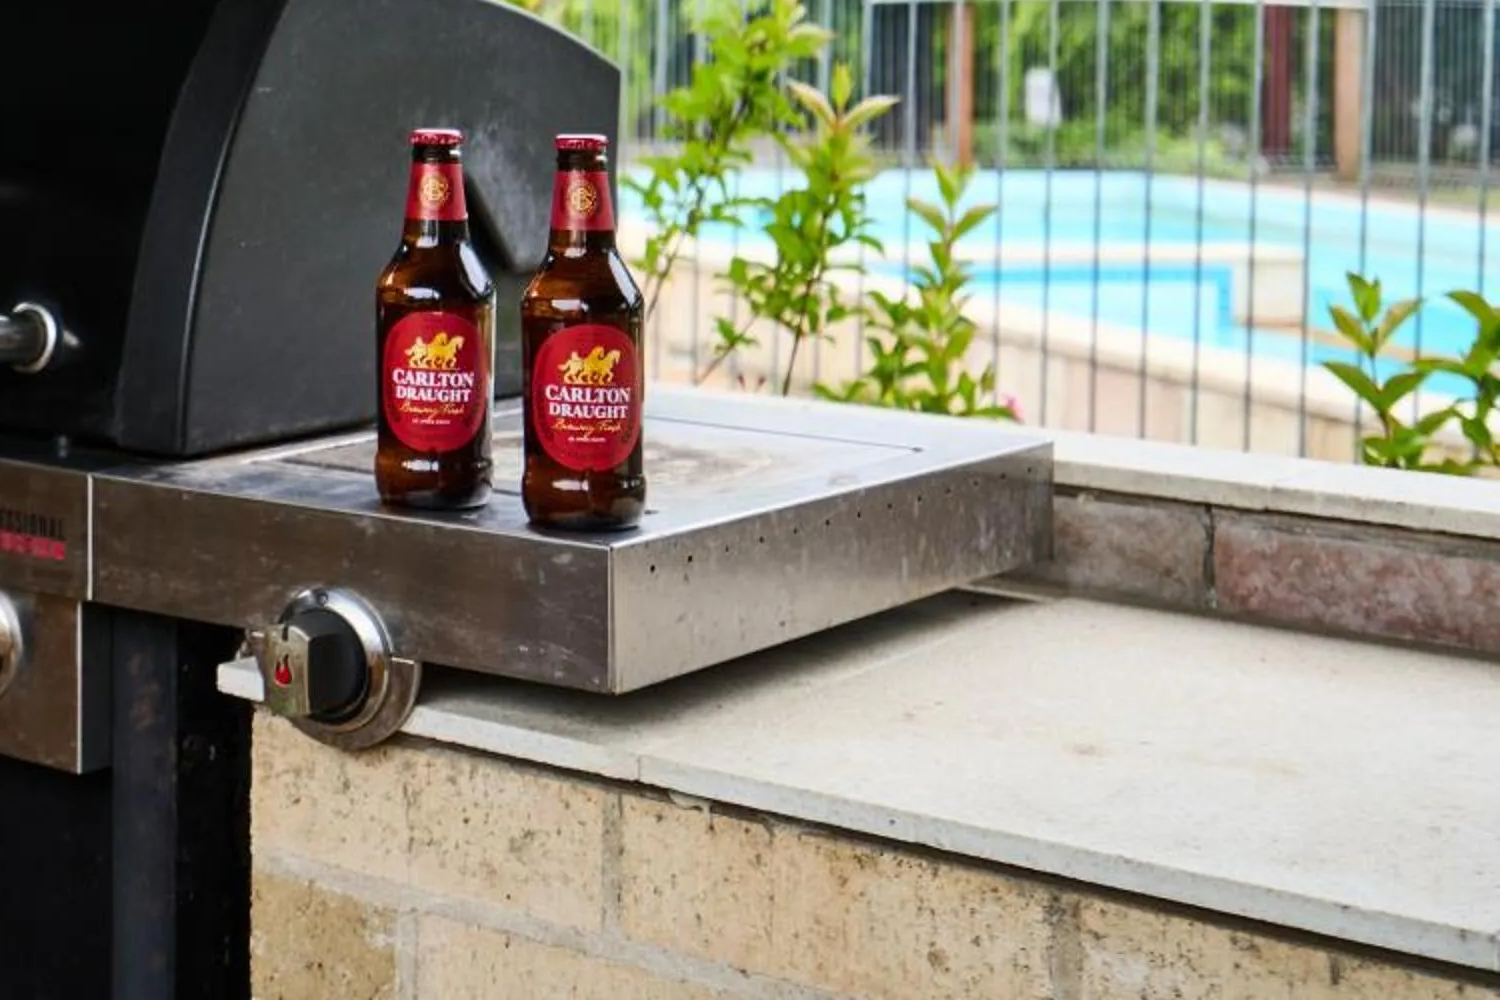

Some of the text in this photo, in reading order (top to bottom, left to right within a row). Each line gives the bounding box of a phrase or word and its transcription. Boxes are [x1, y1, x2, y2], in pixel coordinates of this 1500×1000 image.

[392, 368, 475, 388] CARLTON
[395, 385, 472, 403] DRAUGHT
[545, 384, 631, 404] CARLTON
[548, 401, 629, 419] DRAUGHT
